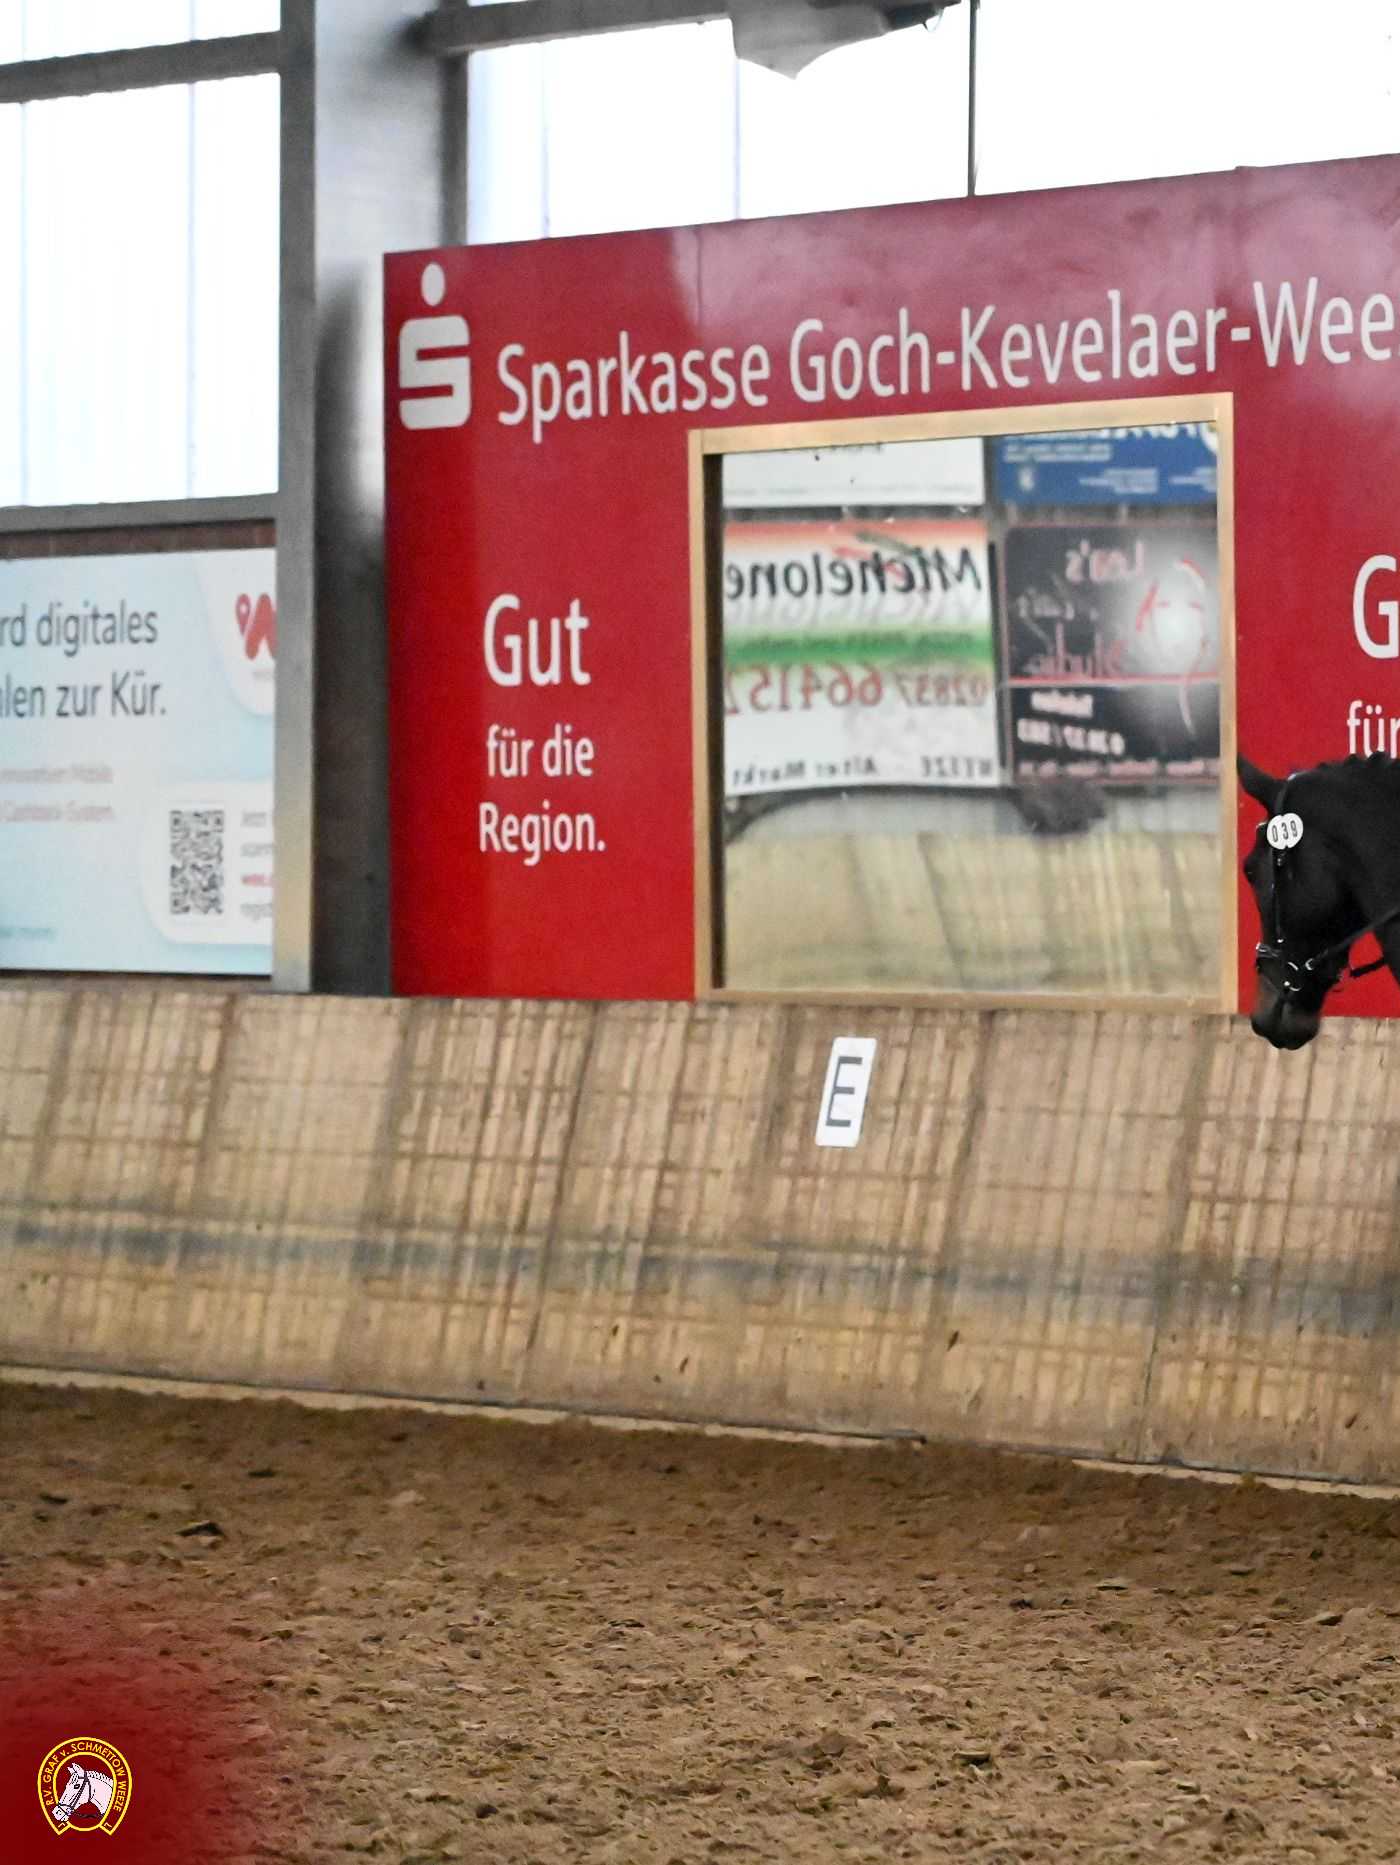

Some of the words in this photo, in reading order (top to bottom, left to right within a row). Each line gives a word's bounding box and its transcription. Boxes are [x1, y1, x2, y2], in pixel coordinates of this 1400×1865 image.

[497, 331, 770, 443] Sparkasse
[36, 598, 158, 658] digitales
[483, 593, 592, 687] Gut
[0, 672, 46, 718] len
[56, 684, 102, 718] zur
[111, 669, 167, 717] Kür.
[486, 724, 535, 778] für
[543, 722, 595, 778] die
[478, 799, 606, 867] Region.
[825, 1055, 863, 1128] E
